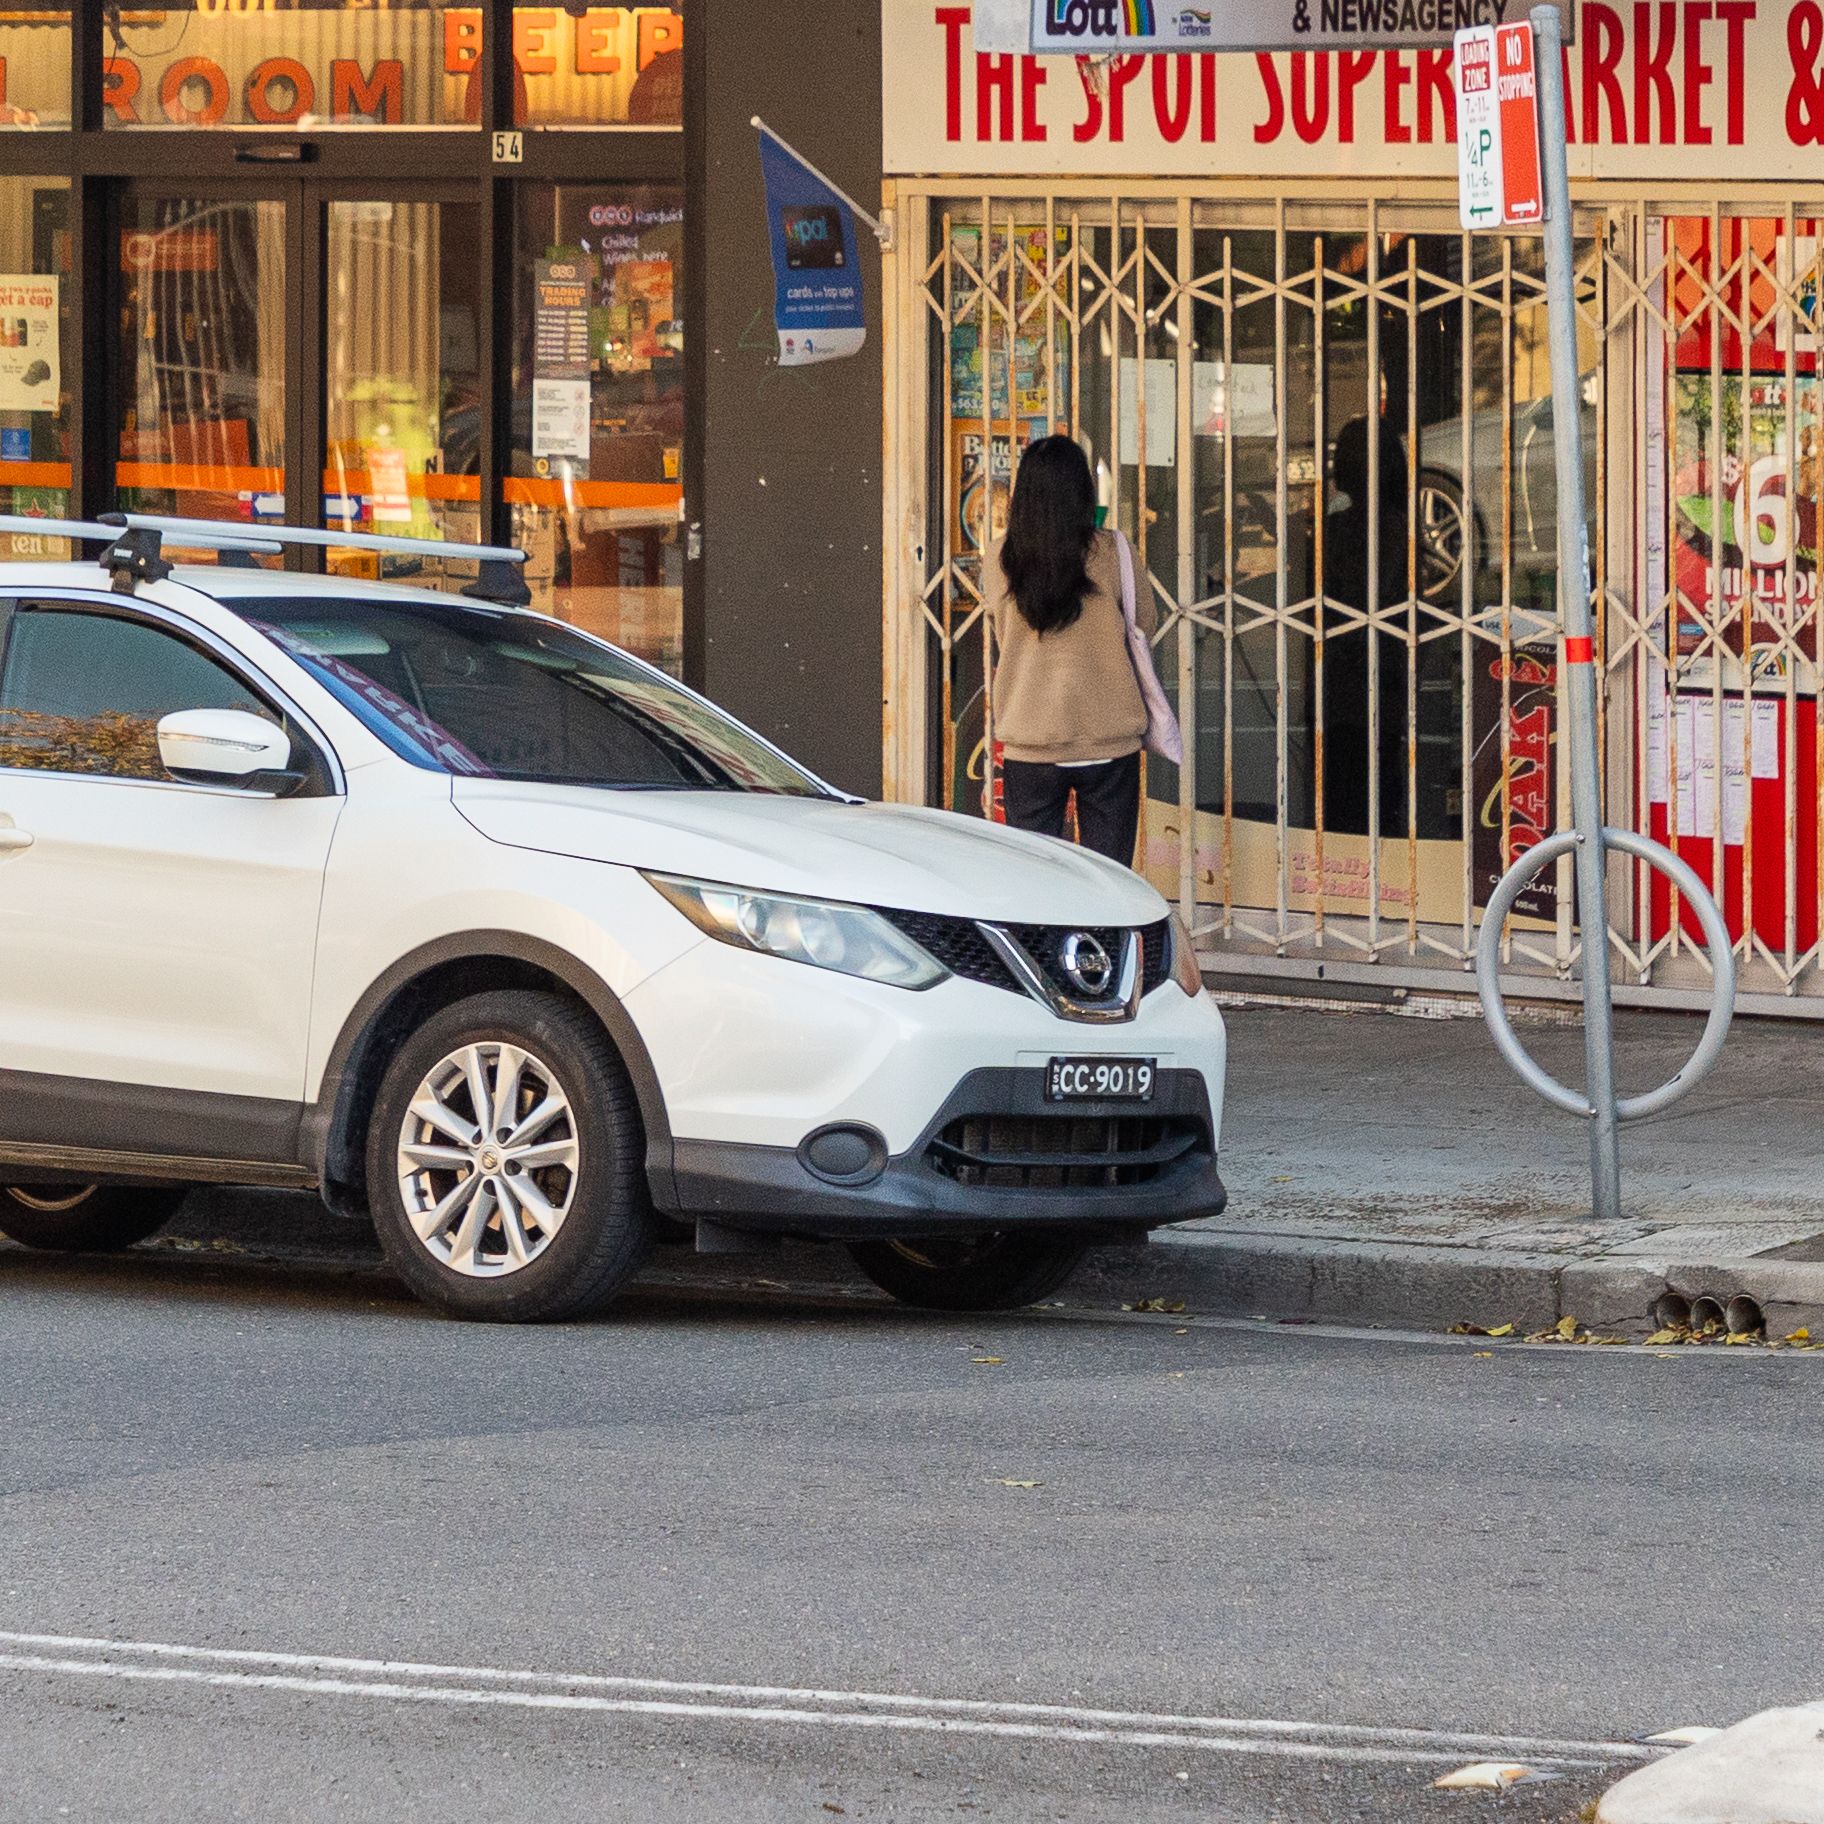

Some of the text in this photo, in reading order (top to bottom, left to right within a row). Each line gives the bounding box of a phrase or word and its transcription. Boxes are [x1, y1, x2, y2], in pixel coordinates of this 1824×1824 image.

[1460, 39, 1490, 66] LOADING
[1505, 34, 1522, 67] NO
[1464, 68, 1490, 92] ZONE
[1496, 70, 1534, 103] STOPPING
[495, 134, 519, 159] 54
[28, 294, 53, 309] cap
